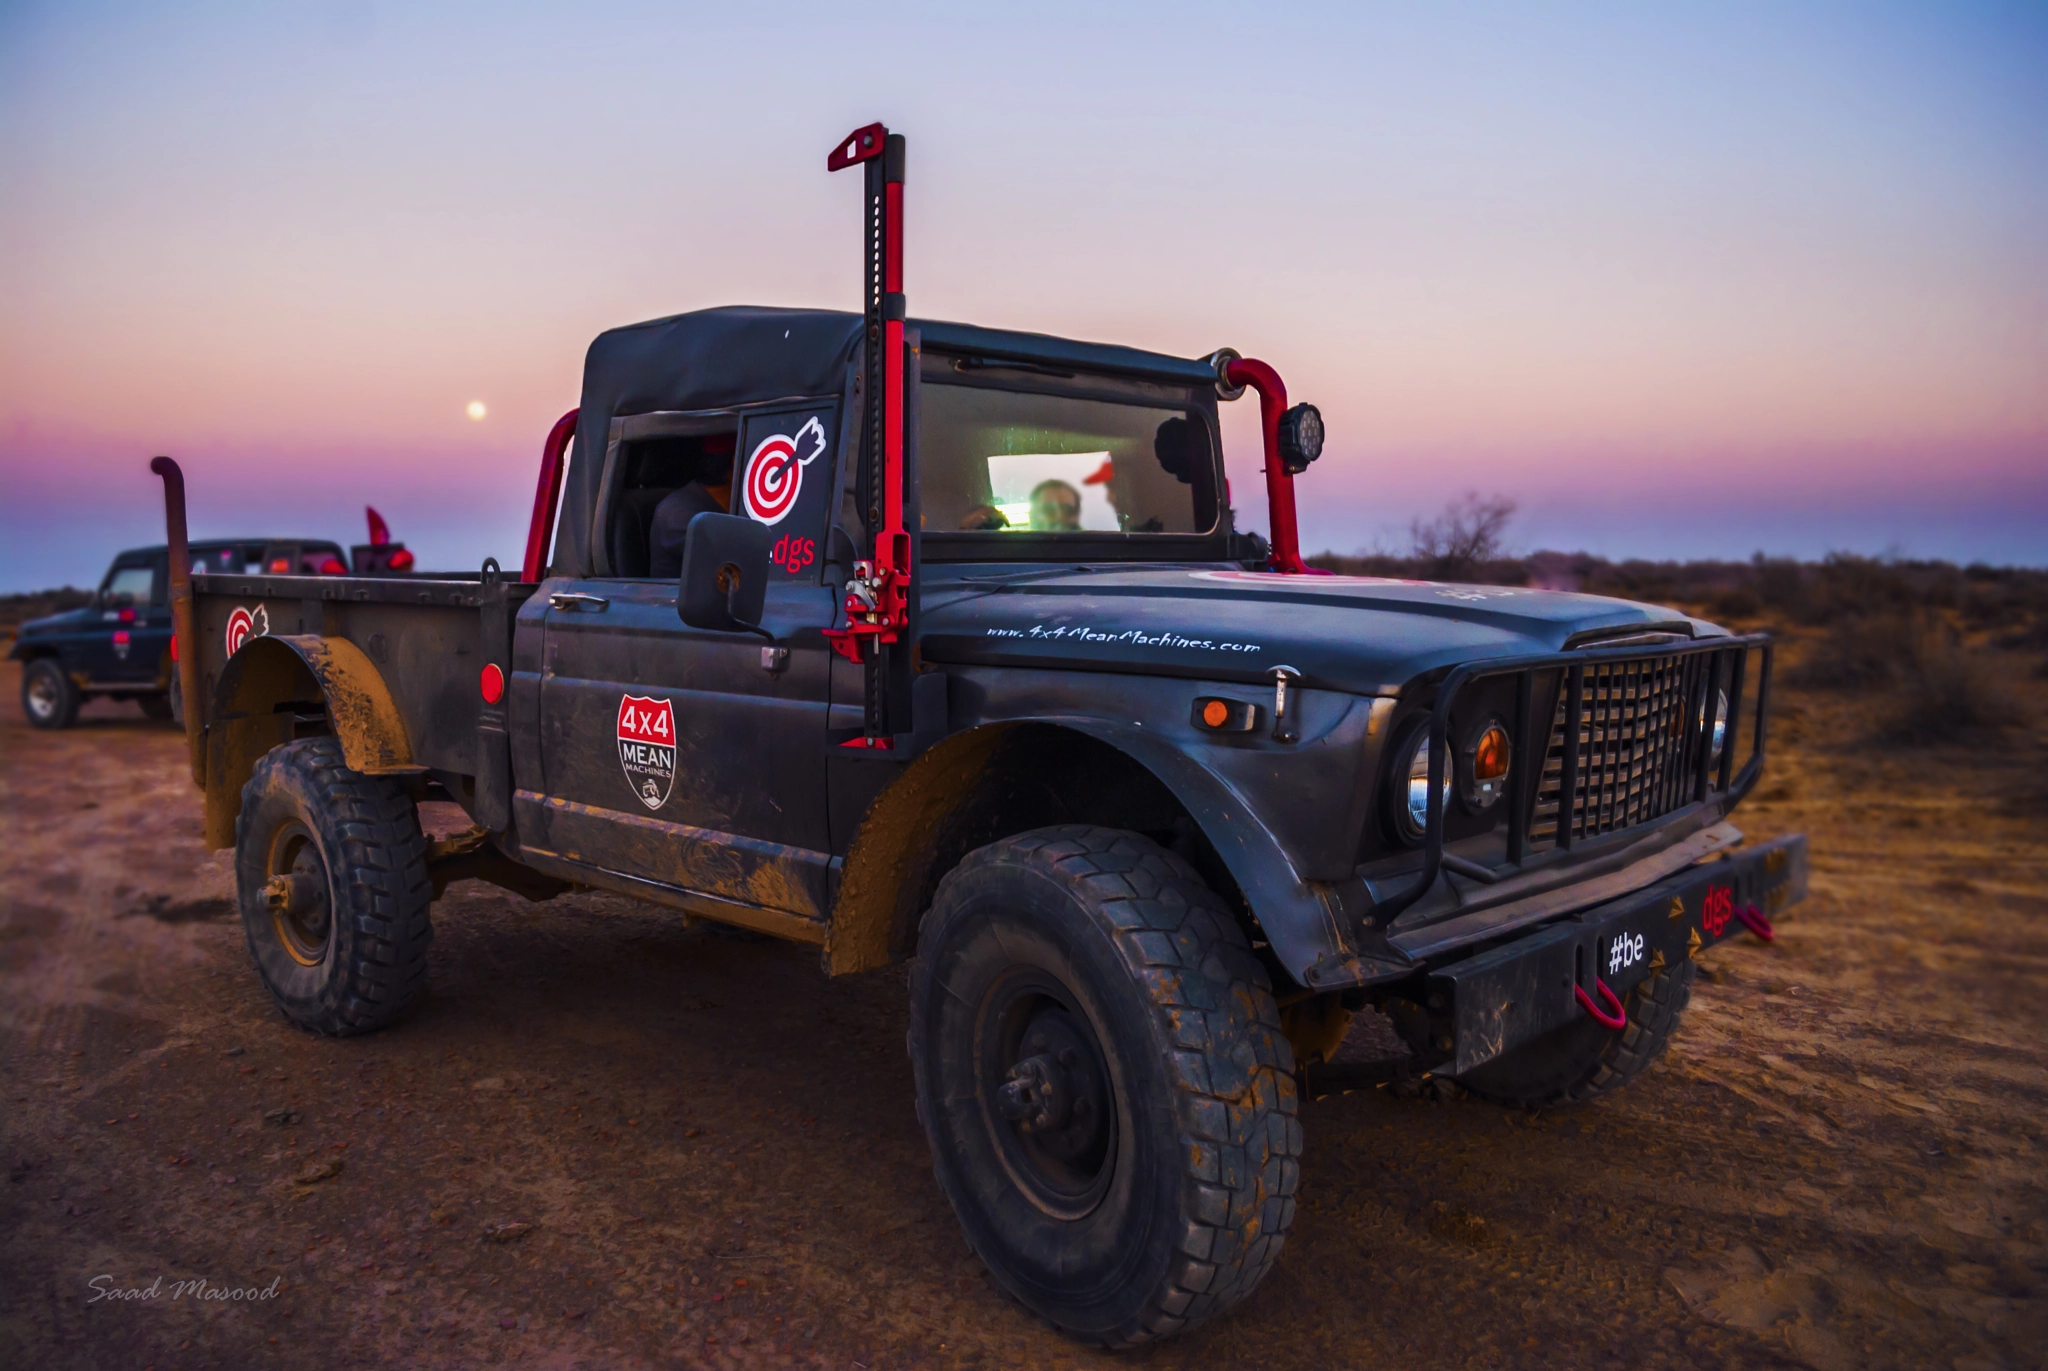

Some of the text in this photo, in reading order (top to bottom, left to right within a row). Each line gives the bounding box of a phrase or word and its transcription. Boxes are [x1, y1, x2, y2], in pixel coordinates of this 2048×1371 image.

[621, 705, 669, 738] 4x4
[623, 743, 672, 769] MEAN
[625, 763, 672, 778] MACHINES
[1609, 884, 1733, 975] #be dgs
